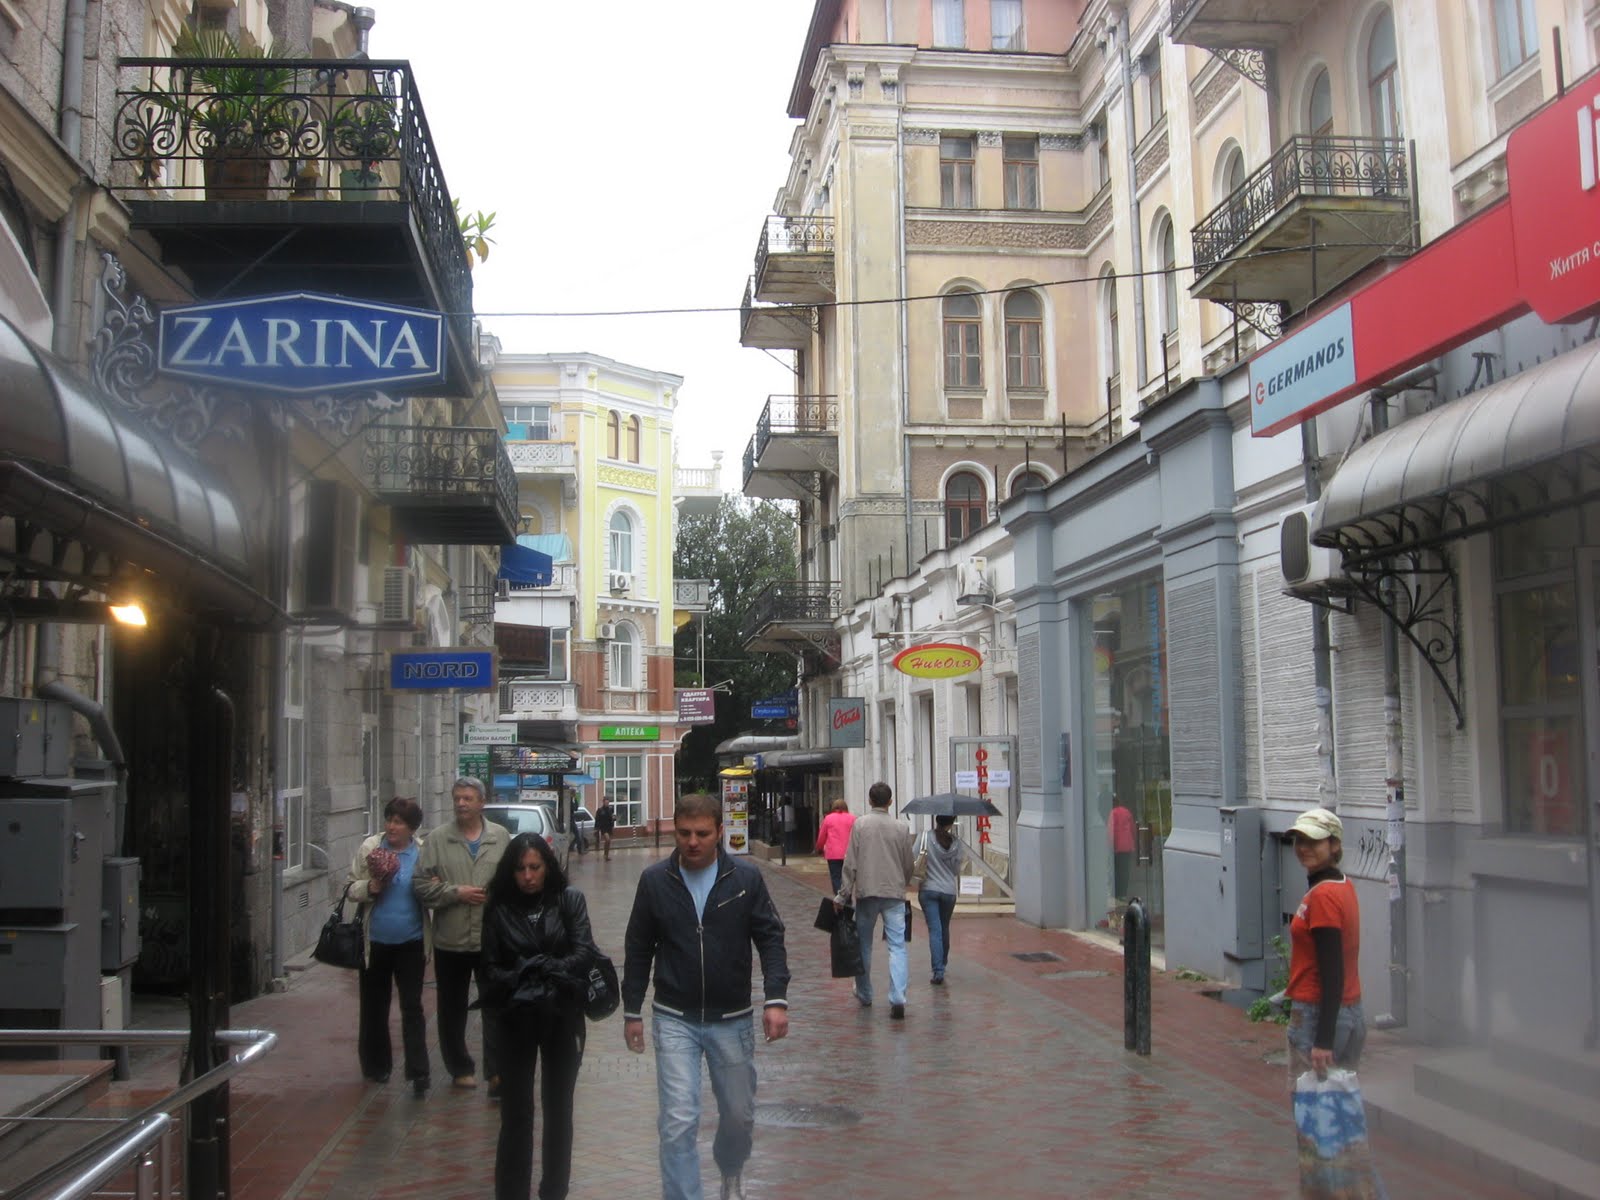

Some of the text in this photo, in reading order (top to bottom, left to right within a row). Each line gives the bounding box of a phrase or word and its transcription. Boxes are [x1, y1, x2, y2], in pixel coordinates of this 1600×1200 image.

[1549, 247, 1590, 281] Життя
[168, 316, 431, 369] ZARINA
[1268, 336, 1345, 397] GERMANOS
[403, 661, 479, 679] NORD
[615, 727, 645, 736] АПТЕКА
[975, 748, 992, 844] ОДЕДА
